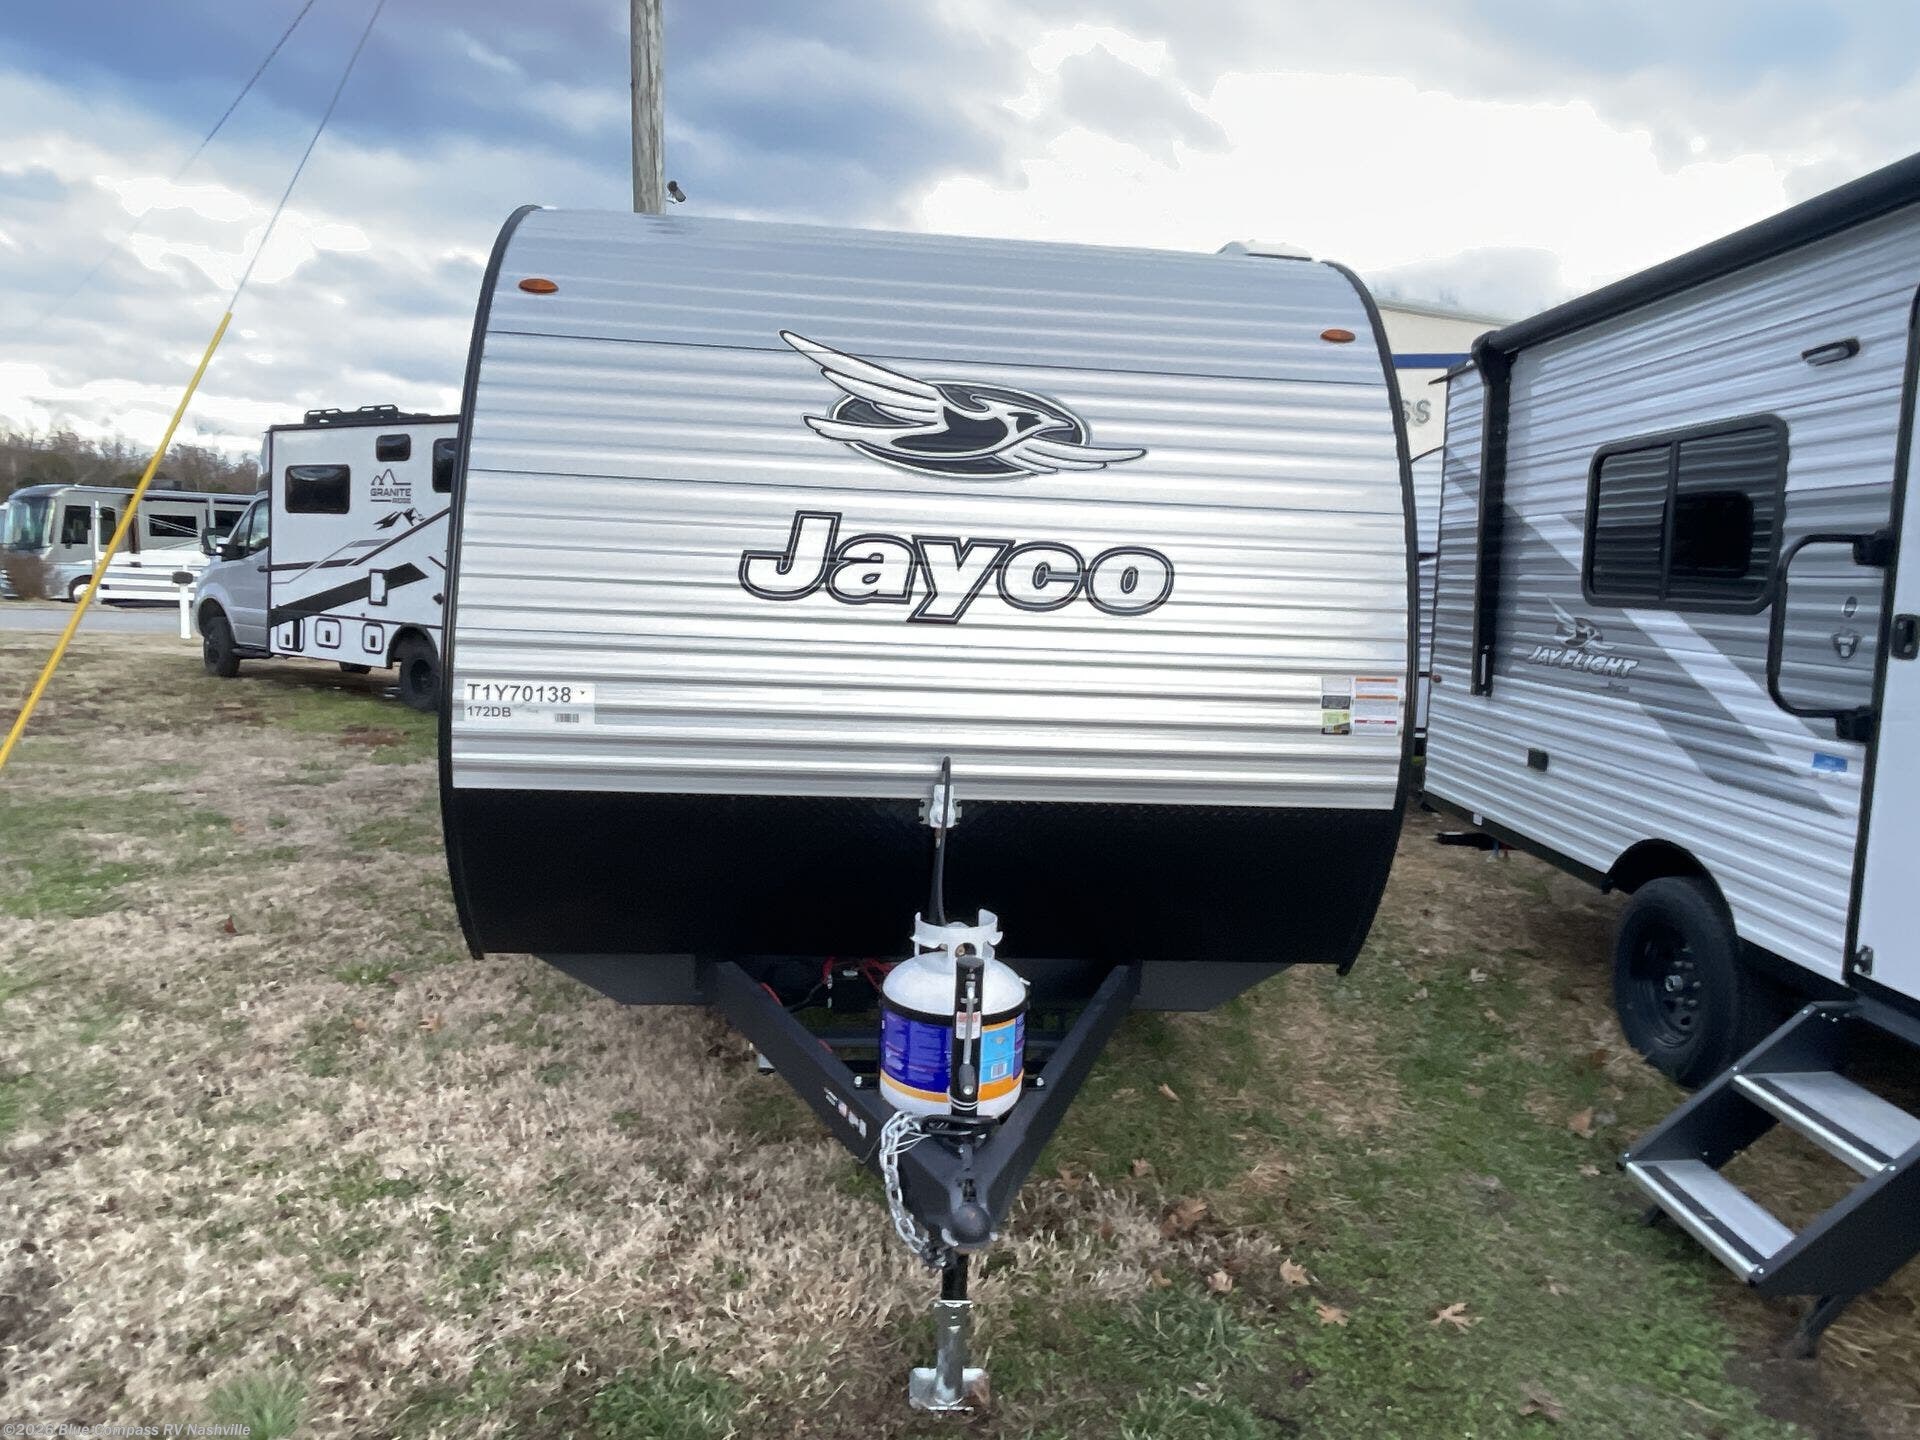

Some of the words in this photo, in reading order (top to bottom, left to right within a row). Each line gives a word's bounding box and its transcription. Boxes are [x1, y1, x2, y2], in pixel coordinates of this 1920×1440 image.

[370, 488, 411, 496] GRANITE
[738, 510, 1175, 624] Jayco
[1528, 645, 1562, 666] JAY
[1561, 649, 1639, 678] FLIGHT
[467, 683, 571, 703] T1Y70138
[467, 705, 512, 718] 172DB
